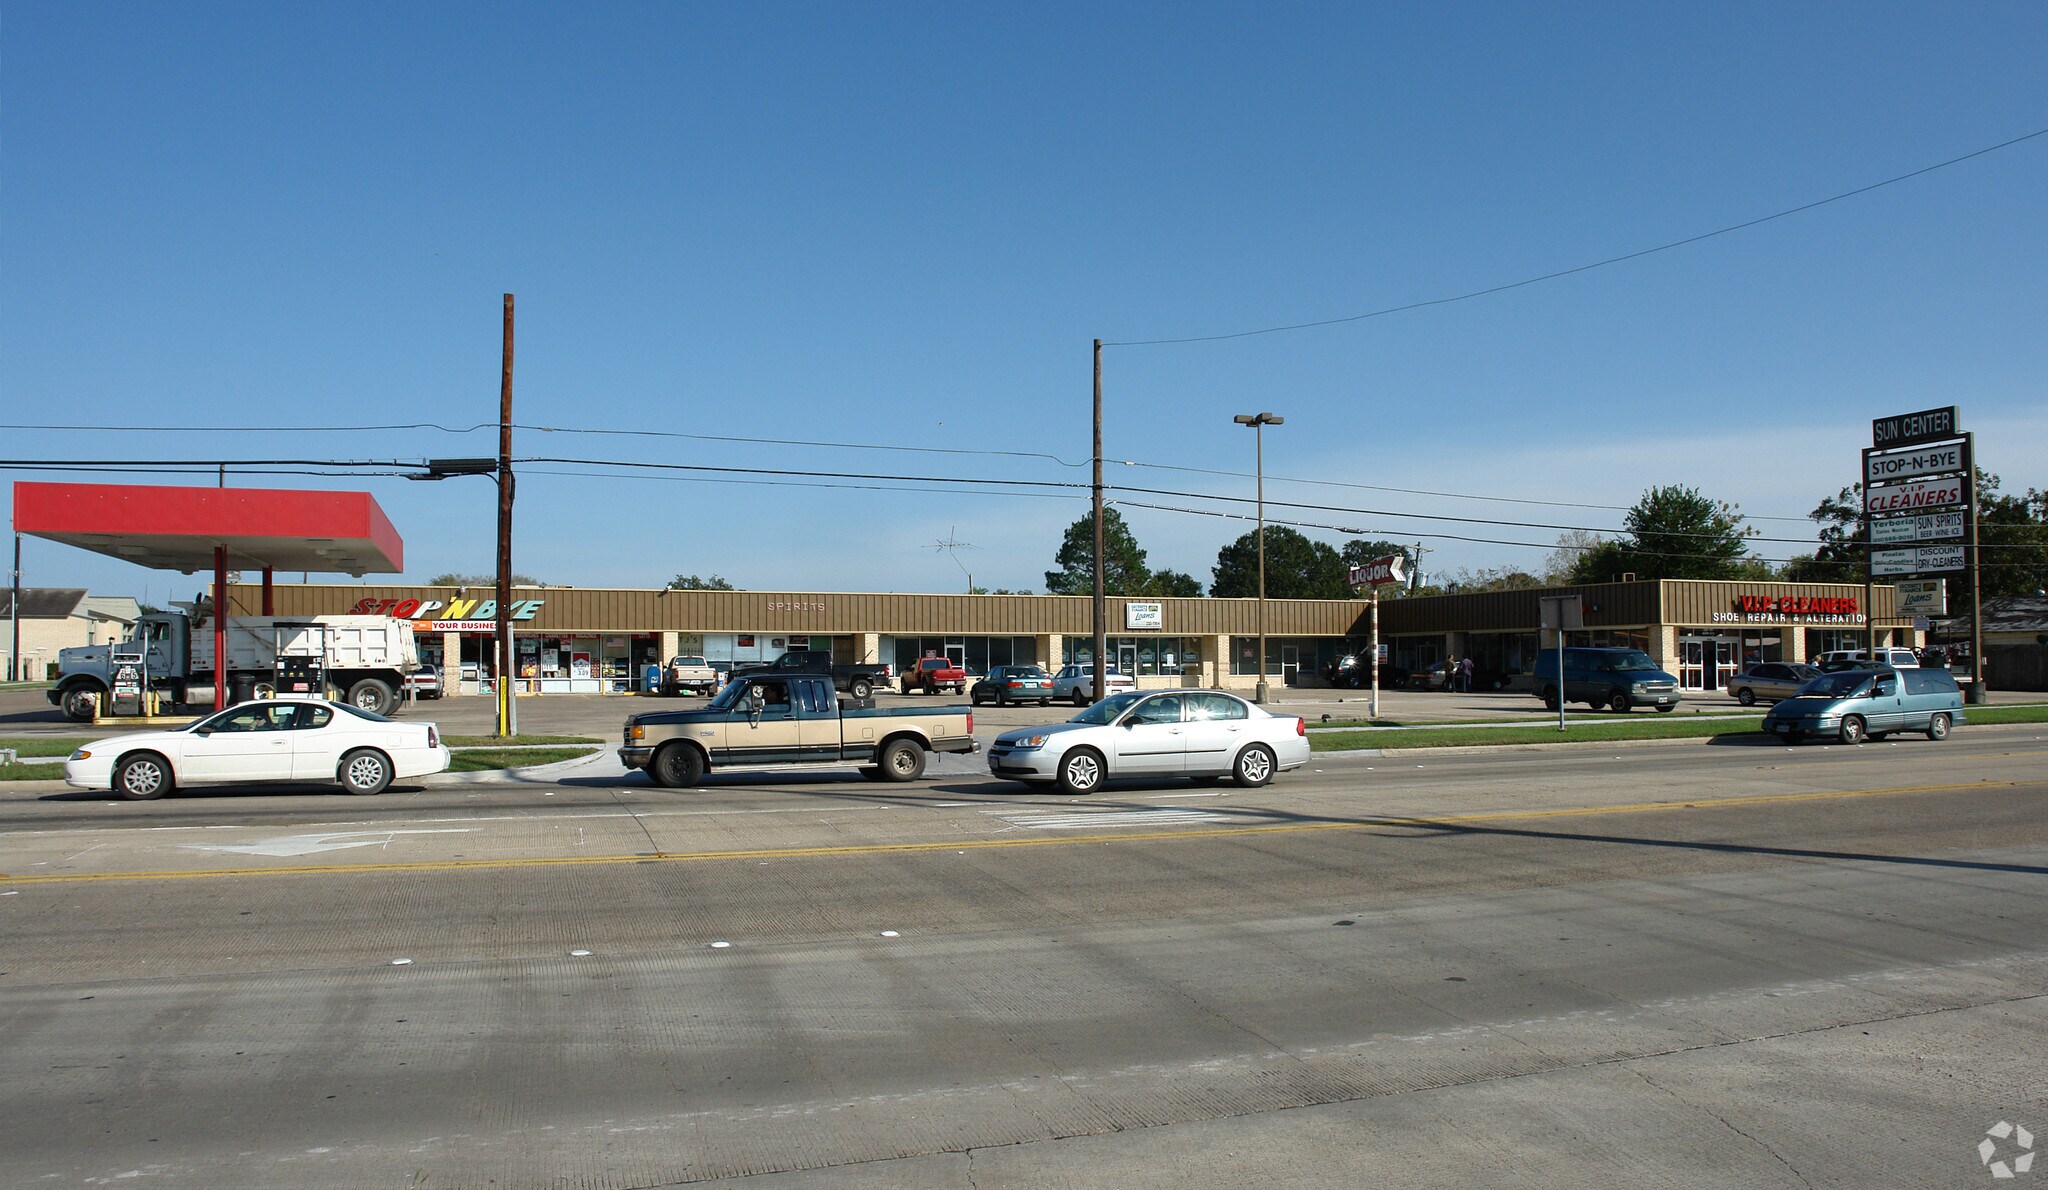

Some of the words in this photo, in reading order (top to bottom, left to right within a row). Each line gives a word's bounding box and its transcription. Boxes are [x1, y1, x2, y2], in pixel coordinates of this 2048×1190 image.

[1875, 420, 1898, 441] SUN
[1903, 411, 1950, 437] CENTER
[1872, 452, 1956, 475] STOP-N-BYE
[1868, 487, 1959, 511] CLEANERS
[1918, 516, 1933, 529] SUN
[1936, 513, 1962, 528] SPIRITS
[1920, 530, 1932, 538] BEER
[1935, 528, 1949, 537] WINE
[1920, 546, 1960, 557] DISCOUNT
[1918, 559, 1930, 569] DRY
[1932, 556, 1964, 568] CLEANERS
[1349, 564, 1389, 585] LIQUOR
[767, 602, 825, 611] SPIRITS
[1780, 596, 1858, 614] CLEANERS
[1904, 593, 1933, 606] Loans
[350, 597, 443, 619] STOP
[1134, 612, 1155, 621] Loans
[1713, 612, 1739, 622] SHOE
[1747, 612, 1786, 622] REPAIR
